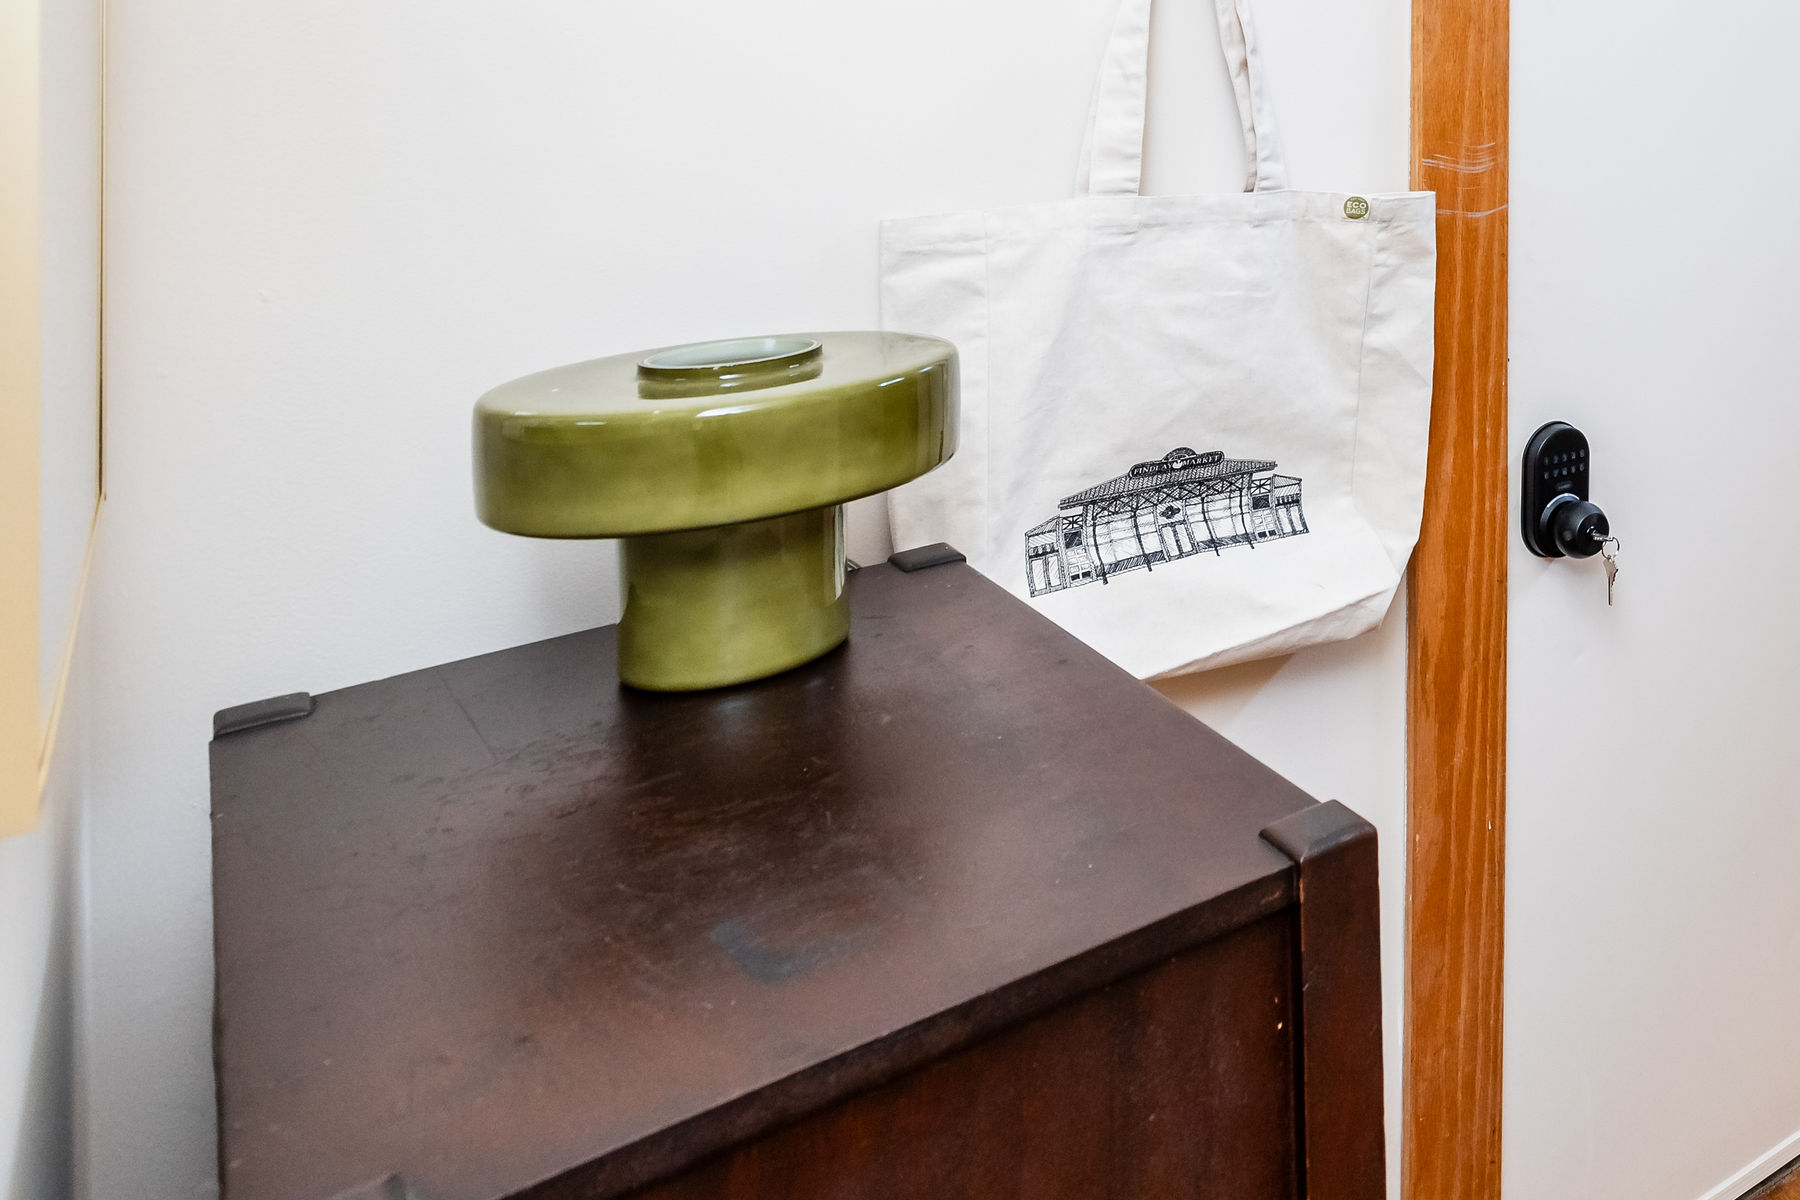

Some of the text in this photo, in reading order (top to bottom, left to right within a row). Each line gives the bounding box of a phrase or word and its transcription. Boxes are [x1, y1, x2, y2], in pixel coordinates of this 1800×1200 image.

[1346, 201, 1367, 209] ECO
[1345, 207, 1366, 215] BAGS
[1133, 455, 1219, 475] FINDLAY MARKET
